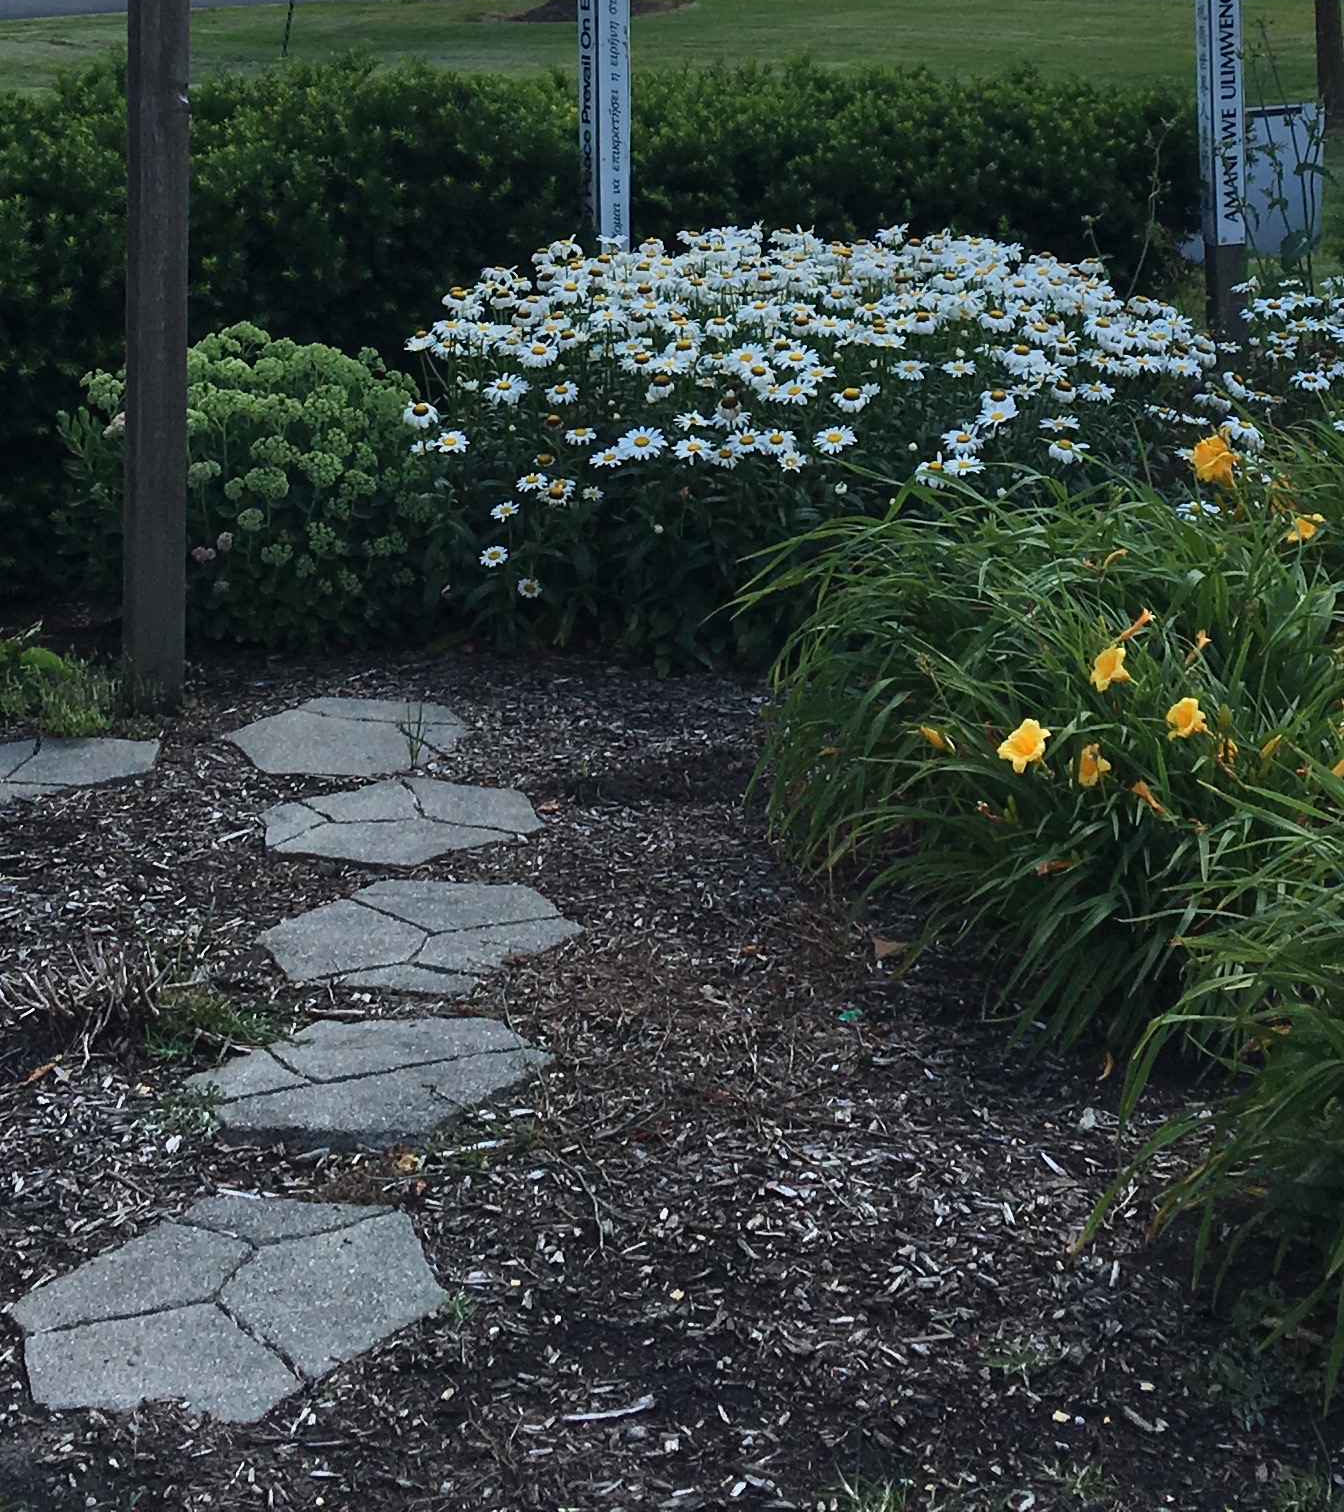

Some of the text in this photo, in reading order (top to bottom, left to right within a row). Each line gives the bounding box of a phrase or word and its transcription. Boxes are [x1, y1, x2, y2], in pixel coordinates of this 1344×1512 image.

[580, 16, 590, 50] On
[580, 55, 591, 125] Prevail
[1222, 157, 1238, 222] AMANI
